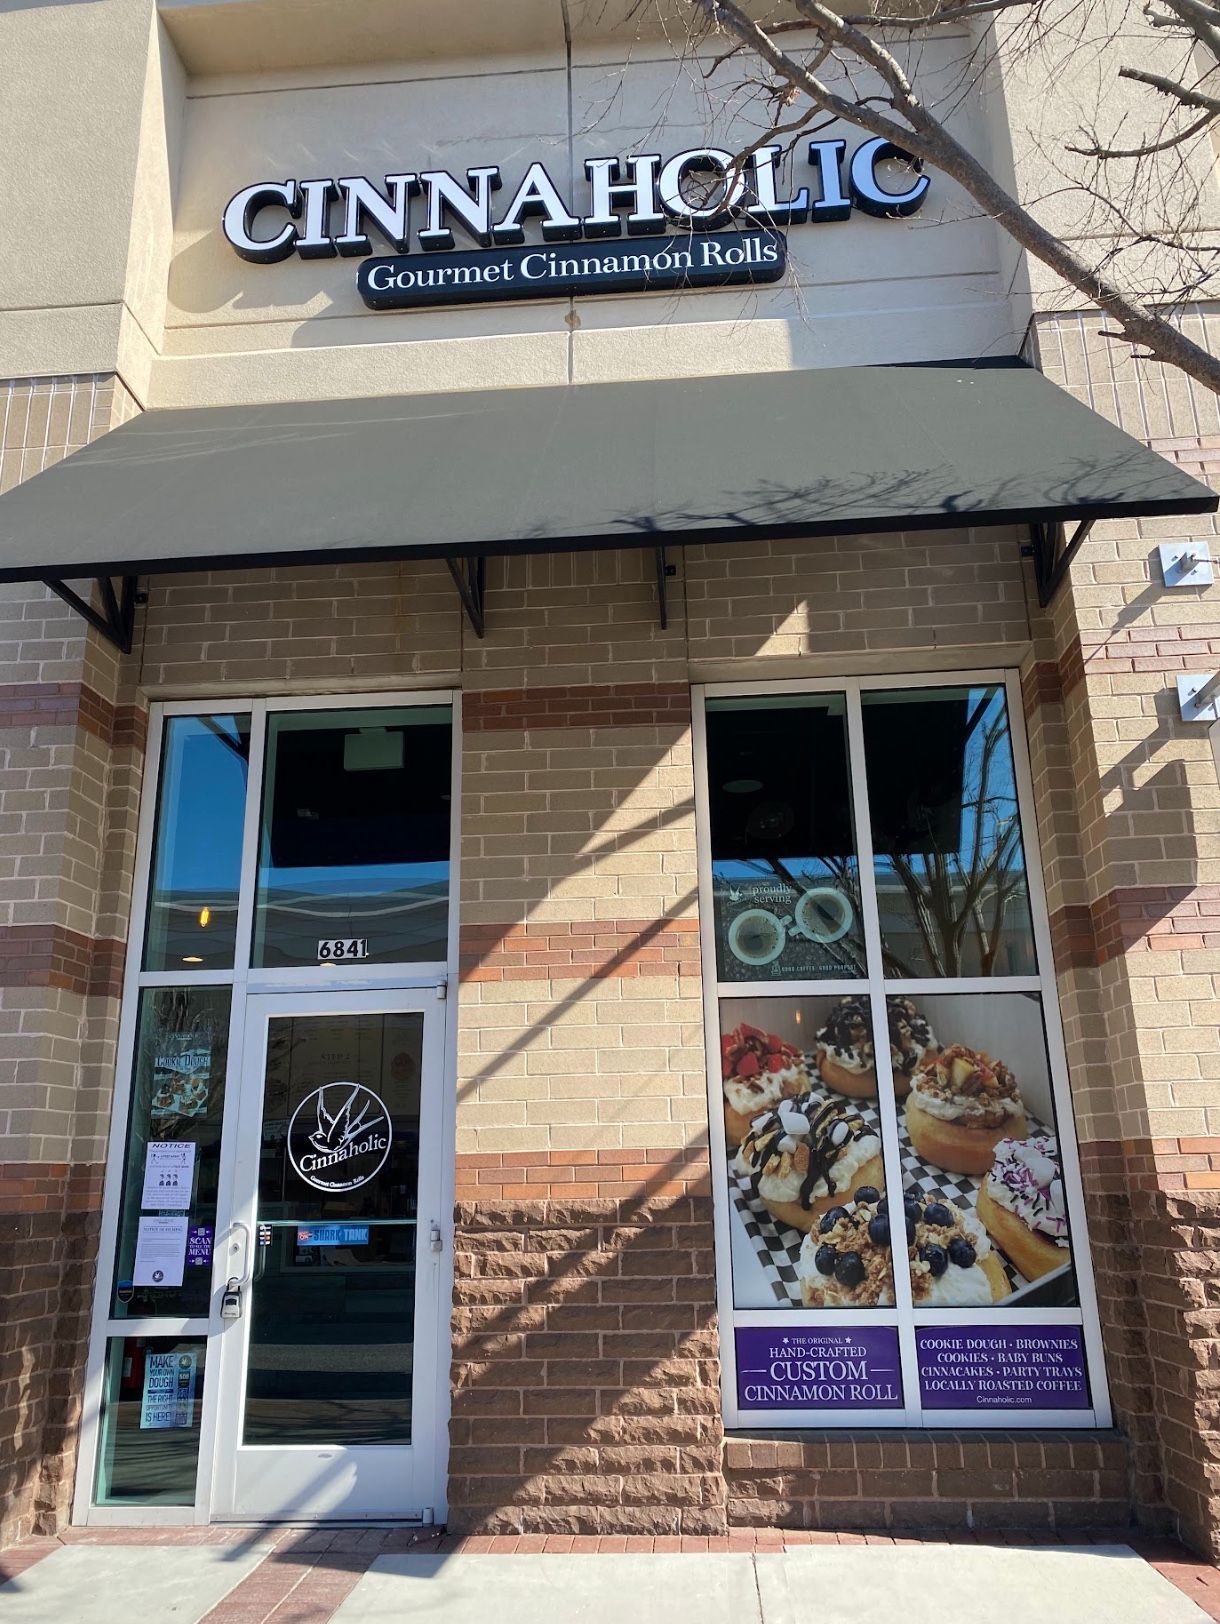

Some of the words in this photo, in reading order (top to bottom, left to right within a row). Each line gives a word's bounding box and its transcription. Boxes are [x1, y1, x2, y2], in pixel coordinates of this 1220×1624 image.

[223, 136, 931, 258] CINNAHOLIC
[366, 260, 514, 291] Gourmet
[520, 246, 694, 287] Cinnamon
[700, 236, 778, 267] Rolls
[752, 883, 792, 897] proudly
[754, 893, 792, 905] serving
[319, 940, 367, 958] 6841
[300, 1134, 387, 1172] Cinnaholic
[313, 1229, 341, 1241] SHARK
[343, 1228, 369, 1241] TANK
[189, 1237, 211, 1245] SCAN
[791, 1337, 806, 1345] THE
[920, 1339, 963, 1350] COOKIE
[966, 1339, 1007, 1350] DOUGH
[1016, 1339, 1078, 1350] BROWNIES
[769, 1346, 867, 1358] HAND-CRAFTED
[937, 1353, 988, 1363] COOKIES
[998, 1353, 1029, 1363] BABY
[1032, 1353, 1063, 1363] BUNS
[150, 1356, 174, 1368] MAKE
[770, 1361, 868, 1381] CUSTOM
[921, 1366, 993, 1377] CINNACAKES
[1003, 1366, 1041, 1377] PARTY
[1043, 1366, 1082, 1377] TRAYS
[148, 1377, 173, 1388] DOUGH
[925, 1380, 976, 1391] LOCALLY
[978, 1380, 1033, 1391] ROASTED
[1036, 1380, 1082, 1391] COFFEE
[744, 1385, 846, 1401] CINNAMON
[850, 1384, 898, 1400] ROLL
[976, 1395, 1032, 1404] Cinnaholic.com
[145, 1412, 152, 1422] IS
